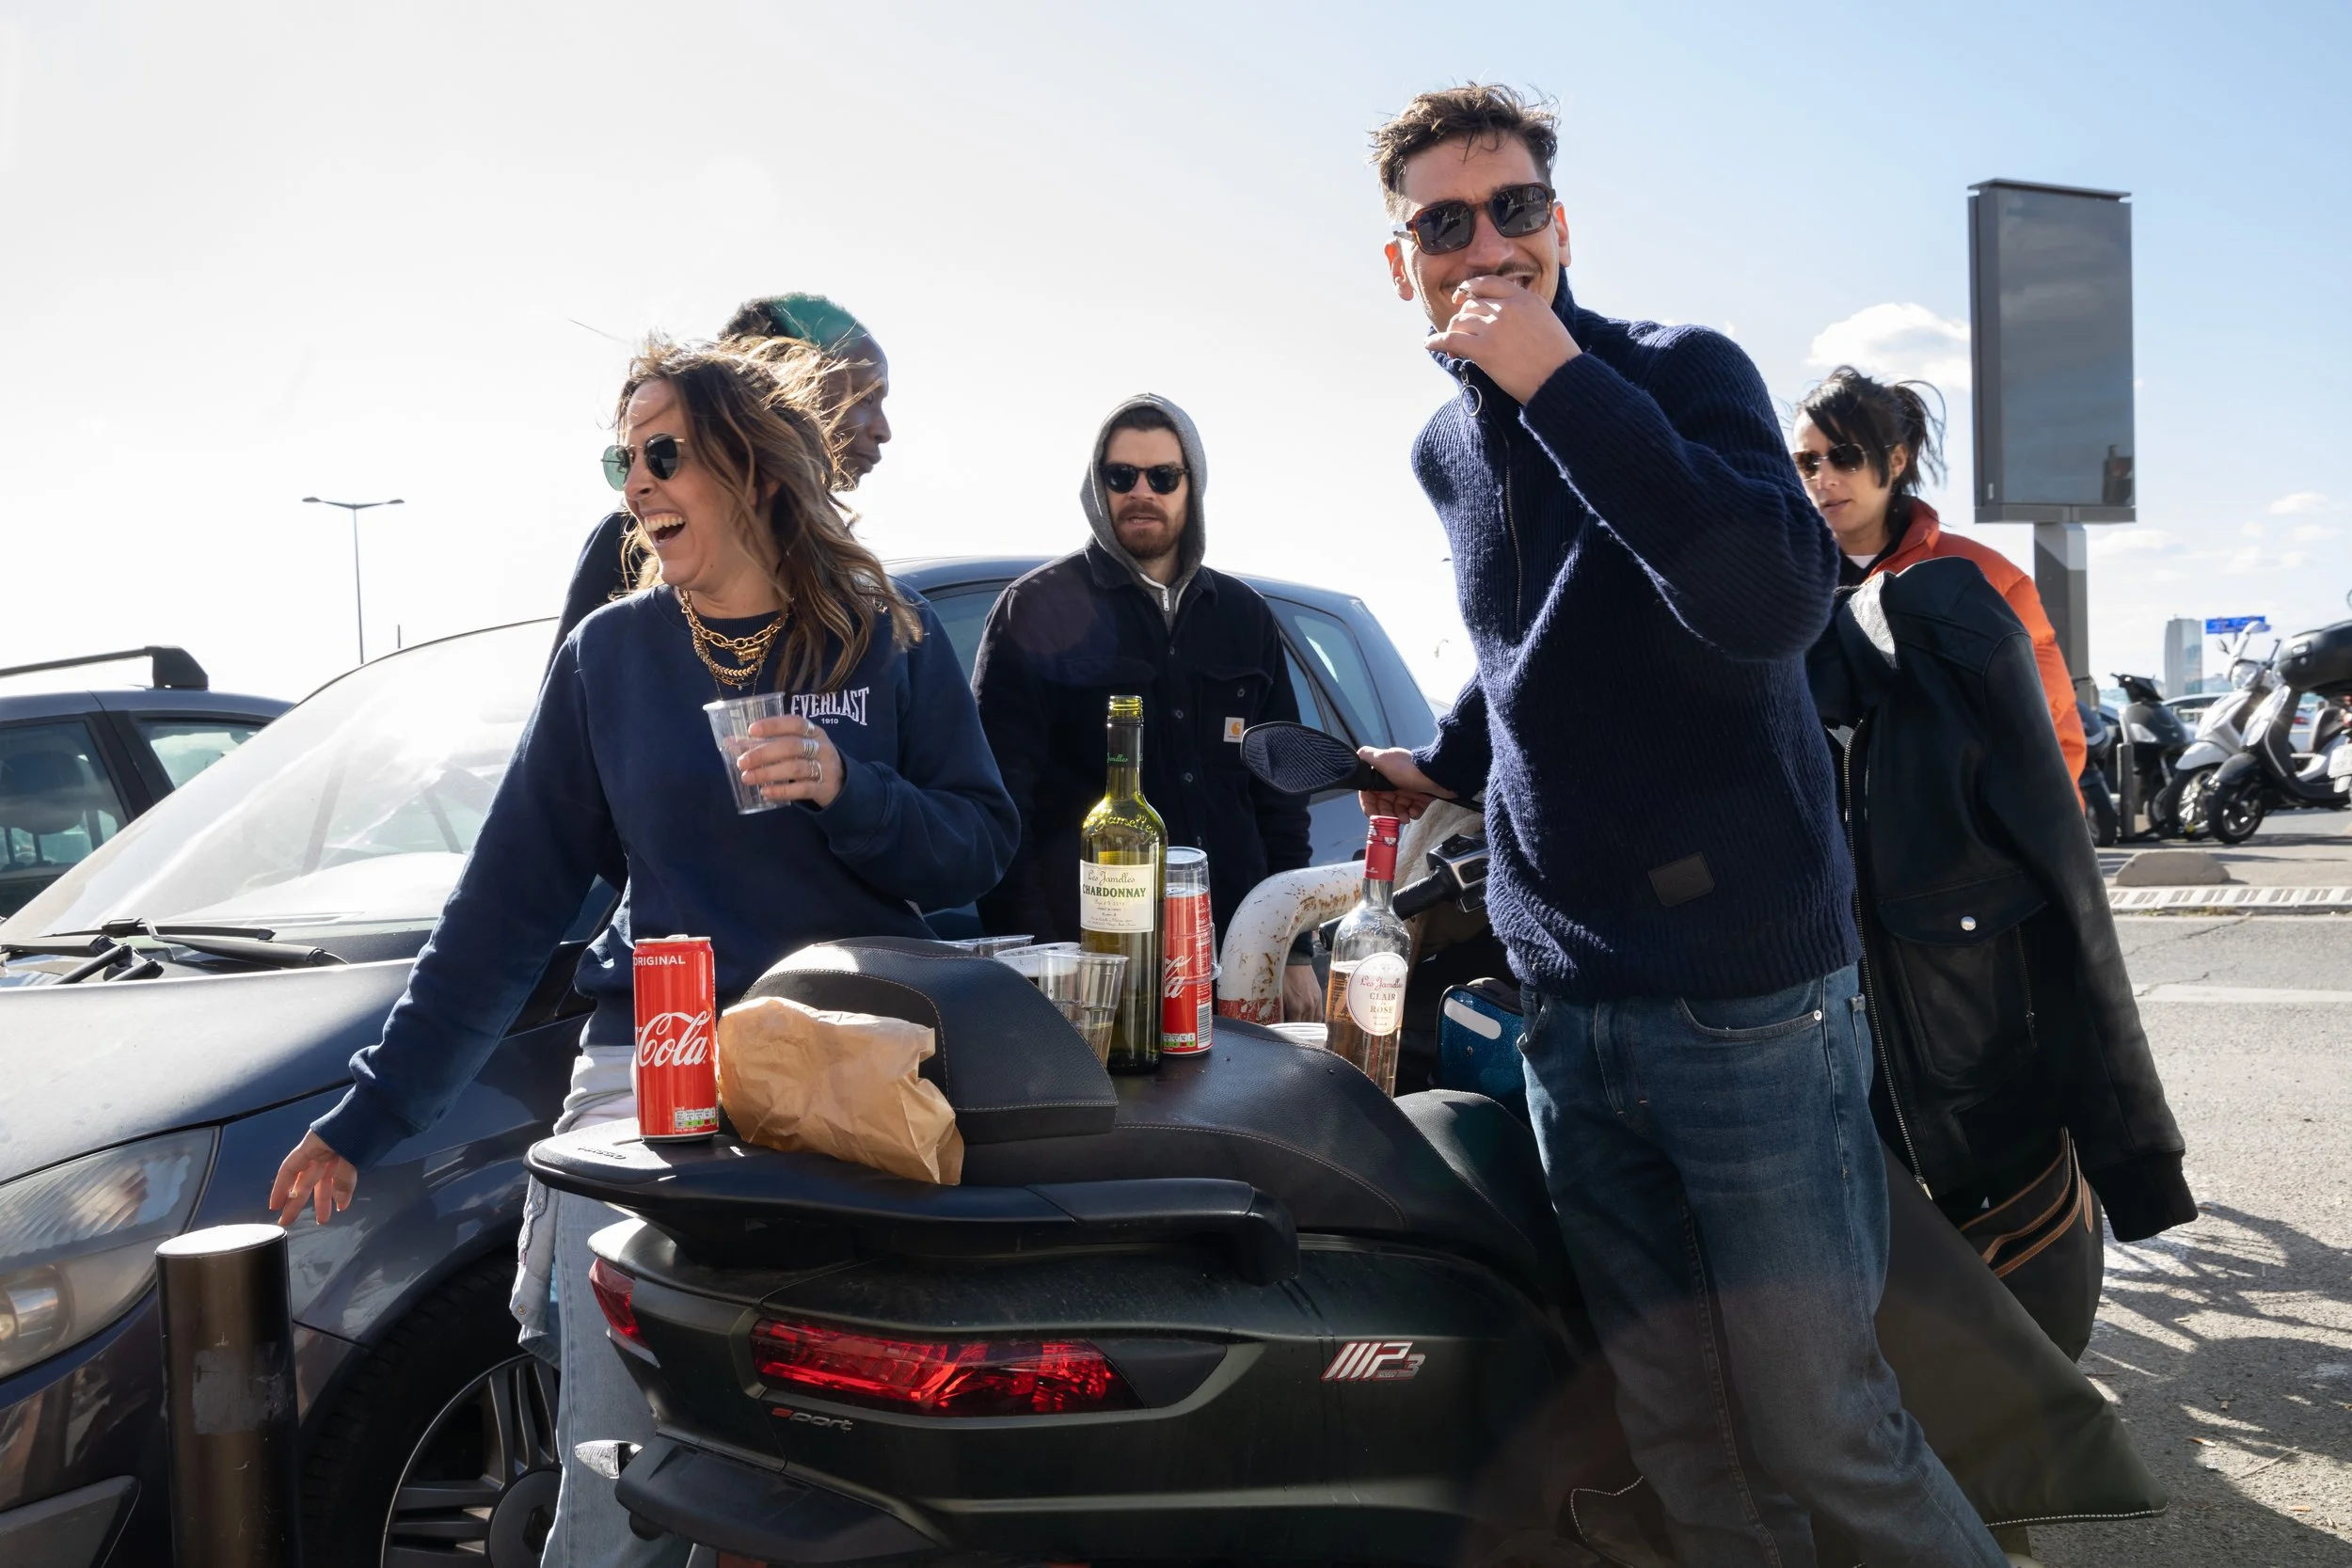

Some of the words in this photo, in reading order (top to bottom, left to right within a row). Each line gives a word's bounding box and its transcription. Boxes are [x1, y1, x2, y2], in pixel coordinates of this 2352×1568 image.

[790, 686, 869, 726] EVERLAST
[1088, 869, 1099, 881] Les
[1099, 870, 1136, 886] Jamelles
[1082, 883, 1147, 898] CHARDONNAY
[633, 955, 687, 966] ORIGINAL
[1360, 975, 1375, 988] Les
[1369, 992, 1396, 1001] CLAIR
[1370, 1005, 1393, 1014] ROSE
